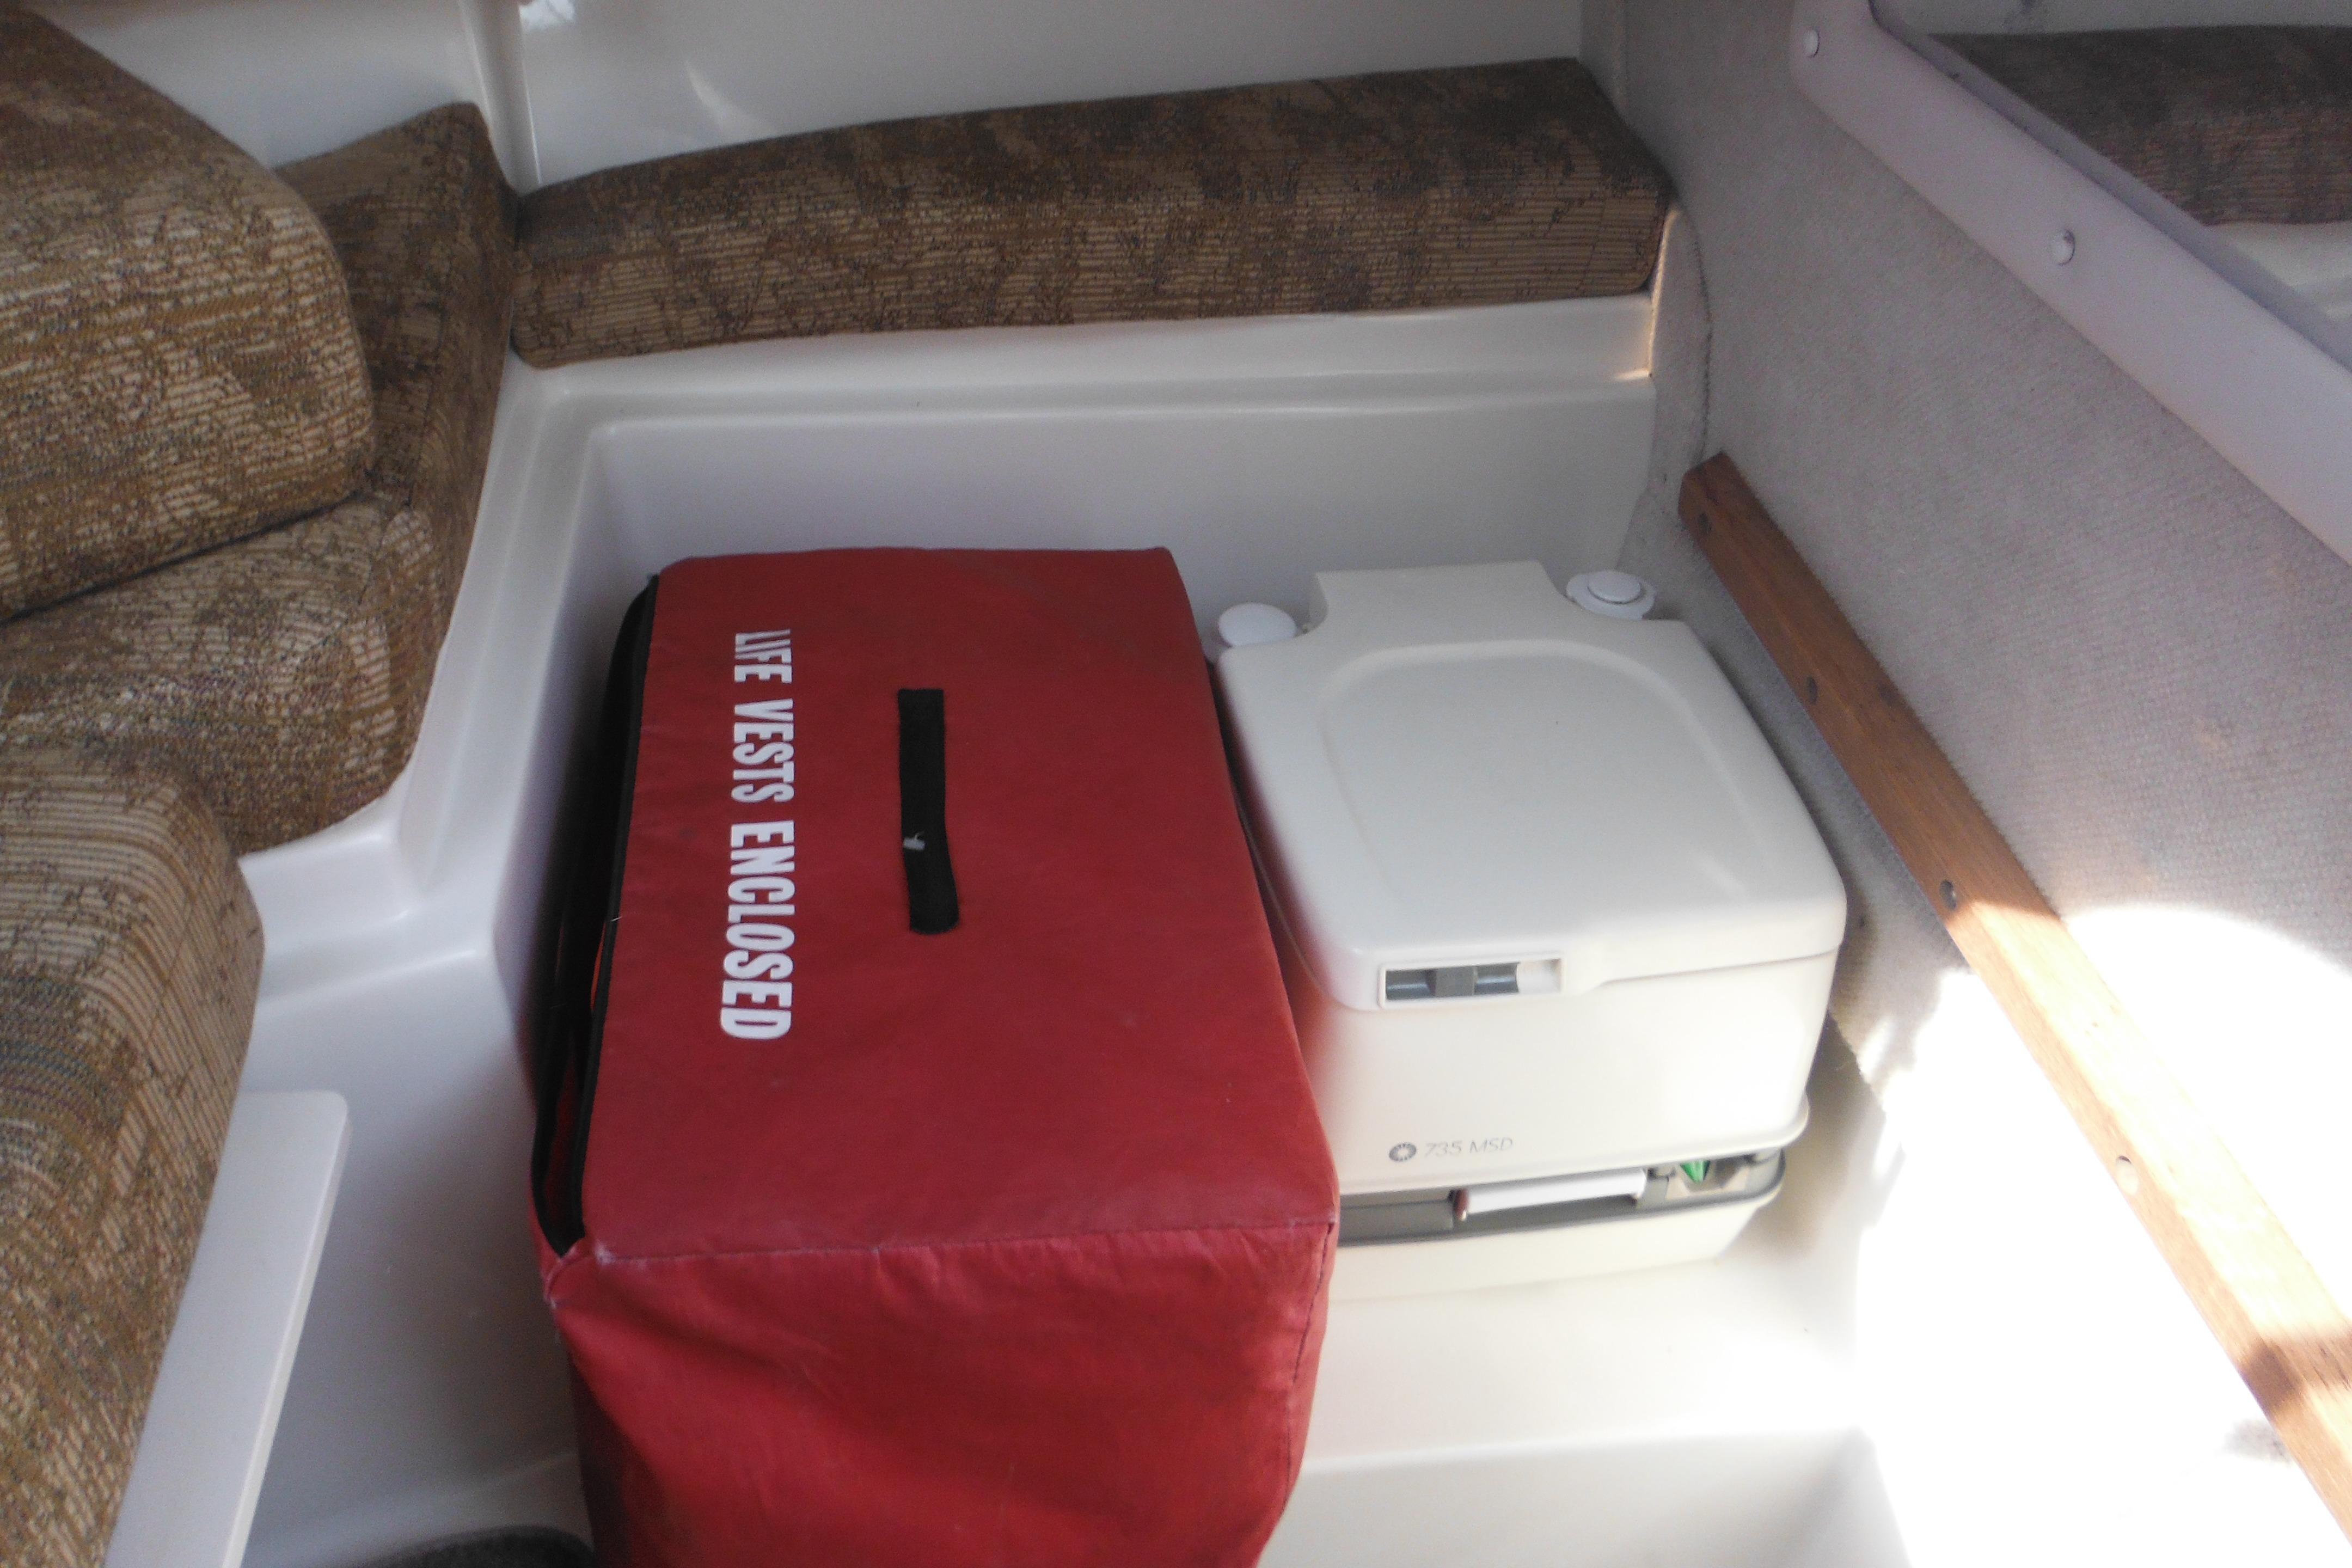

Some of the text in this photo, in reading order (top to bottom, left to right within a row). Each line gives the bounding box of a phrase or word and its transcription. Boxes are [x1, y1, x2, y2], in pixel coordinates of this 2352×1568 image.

[720, 629, 795, 1039] LIFE VESTS ENCLOSED
[1424, 1137, 1513, 1157] 735 MSD
